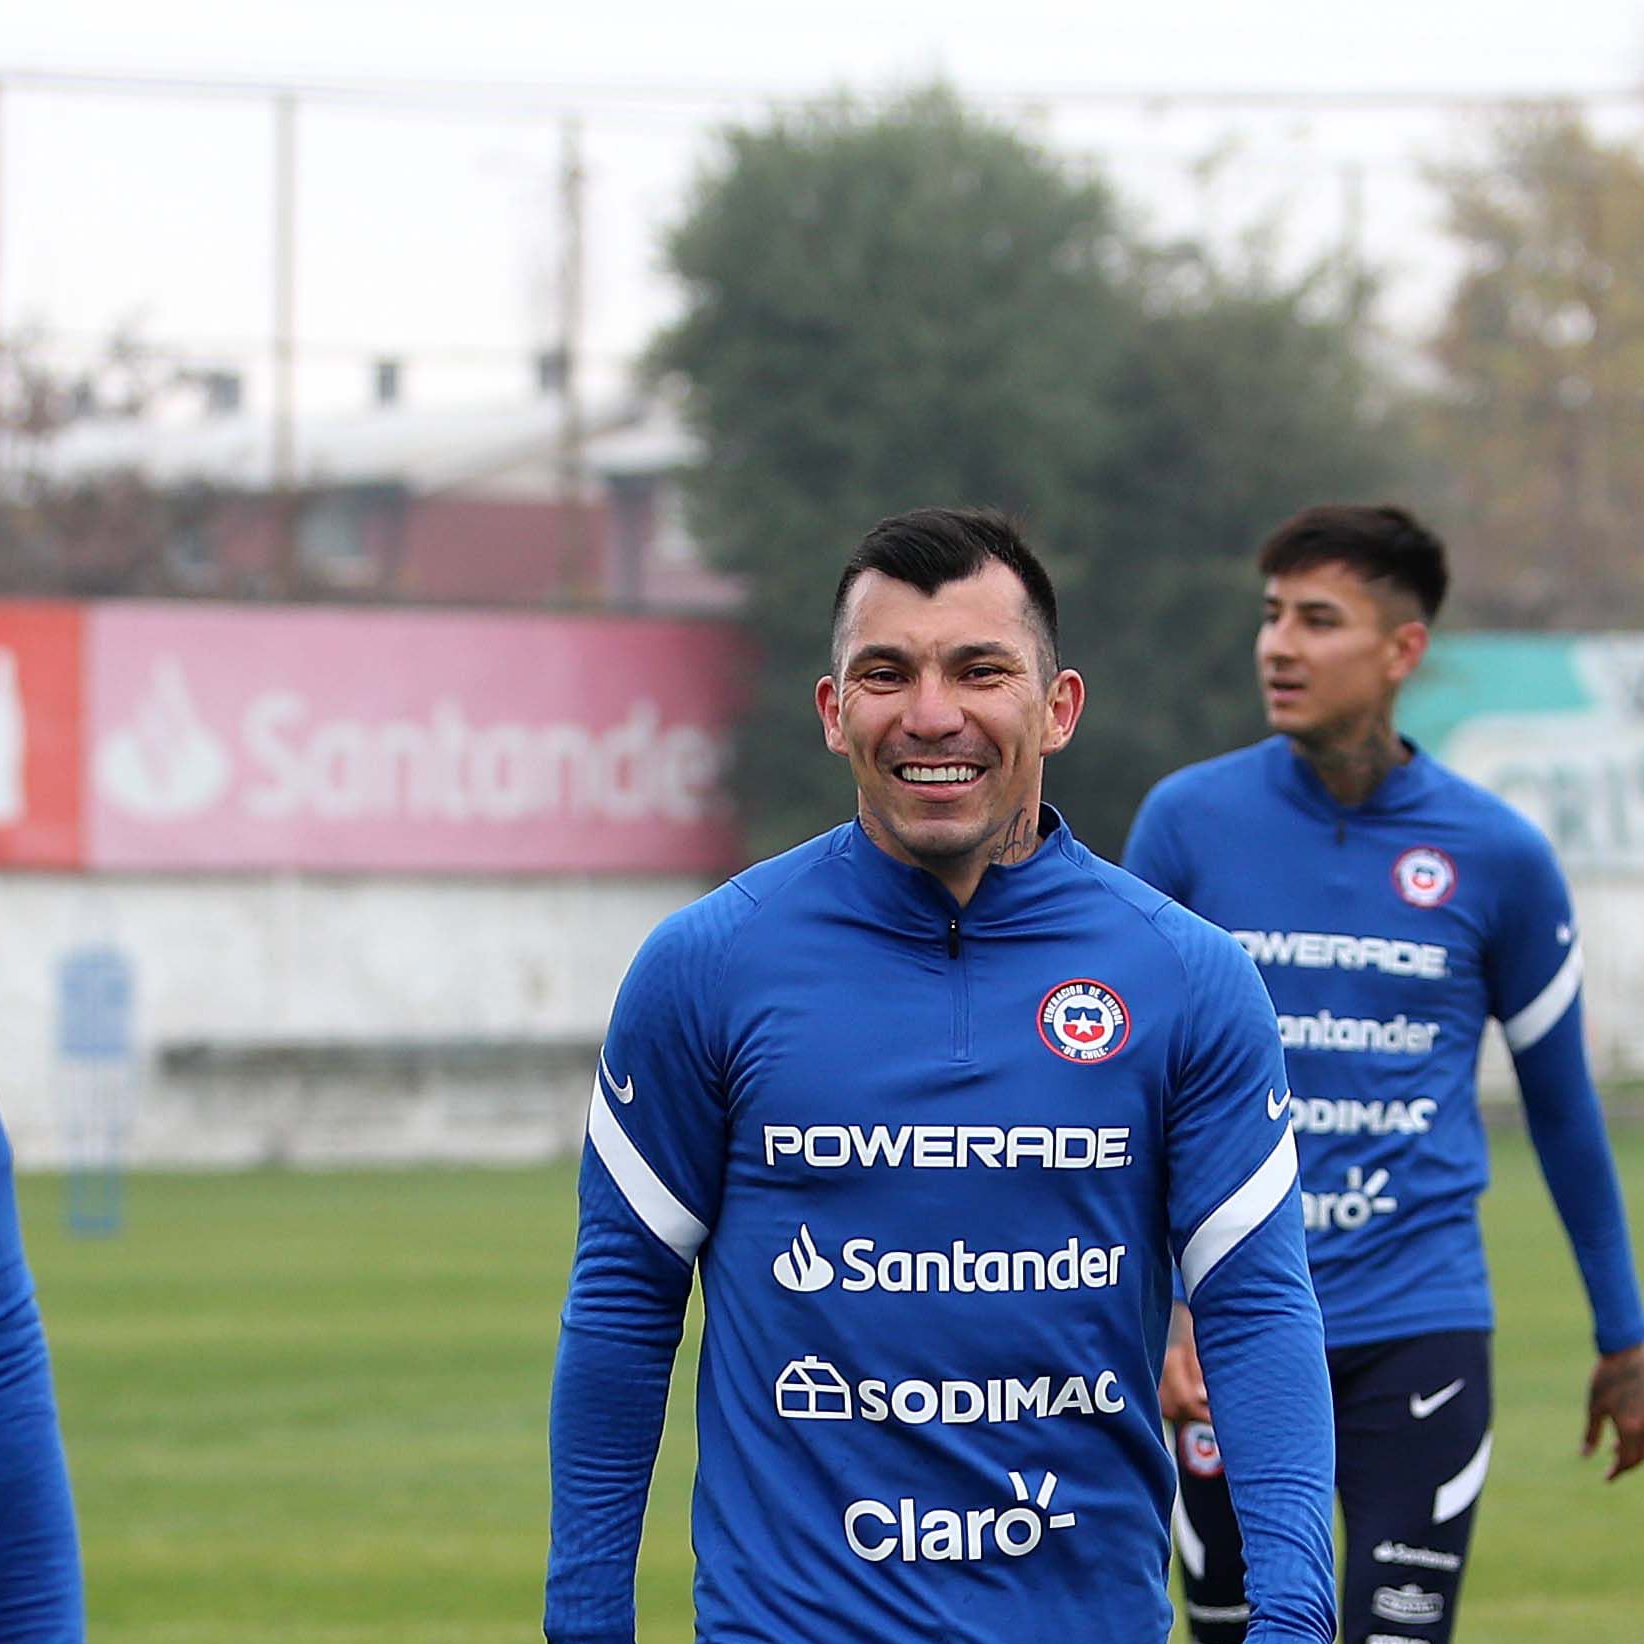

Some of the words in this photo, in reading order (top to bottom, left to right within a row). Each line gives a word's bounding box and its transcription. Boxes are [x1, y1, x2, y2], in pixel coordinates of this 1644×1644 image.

[243, 694, 725, 822] Santande
[1232, 930, 1446, 980] WERADE
[1278, 1008, 1441, 1056] antander
[763, 1125, 1129, 1169] POWERADE
[841, 1237, 1126, 1293] Santander
[858, 1369, 1125, 1424] SODIMAC
[844, 1497, 1044, 1562] Claro
